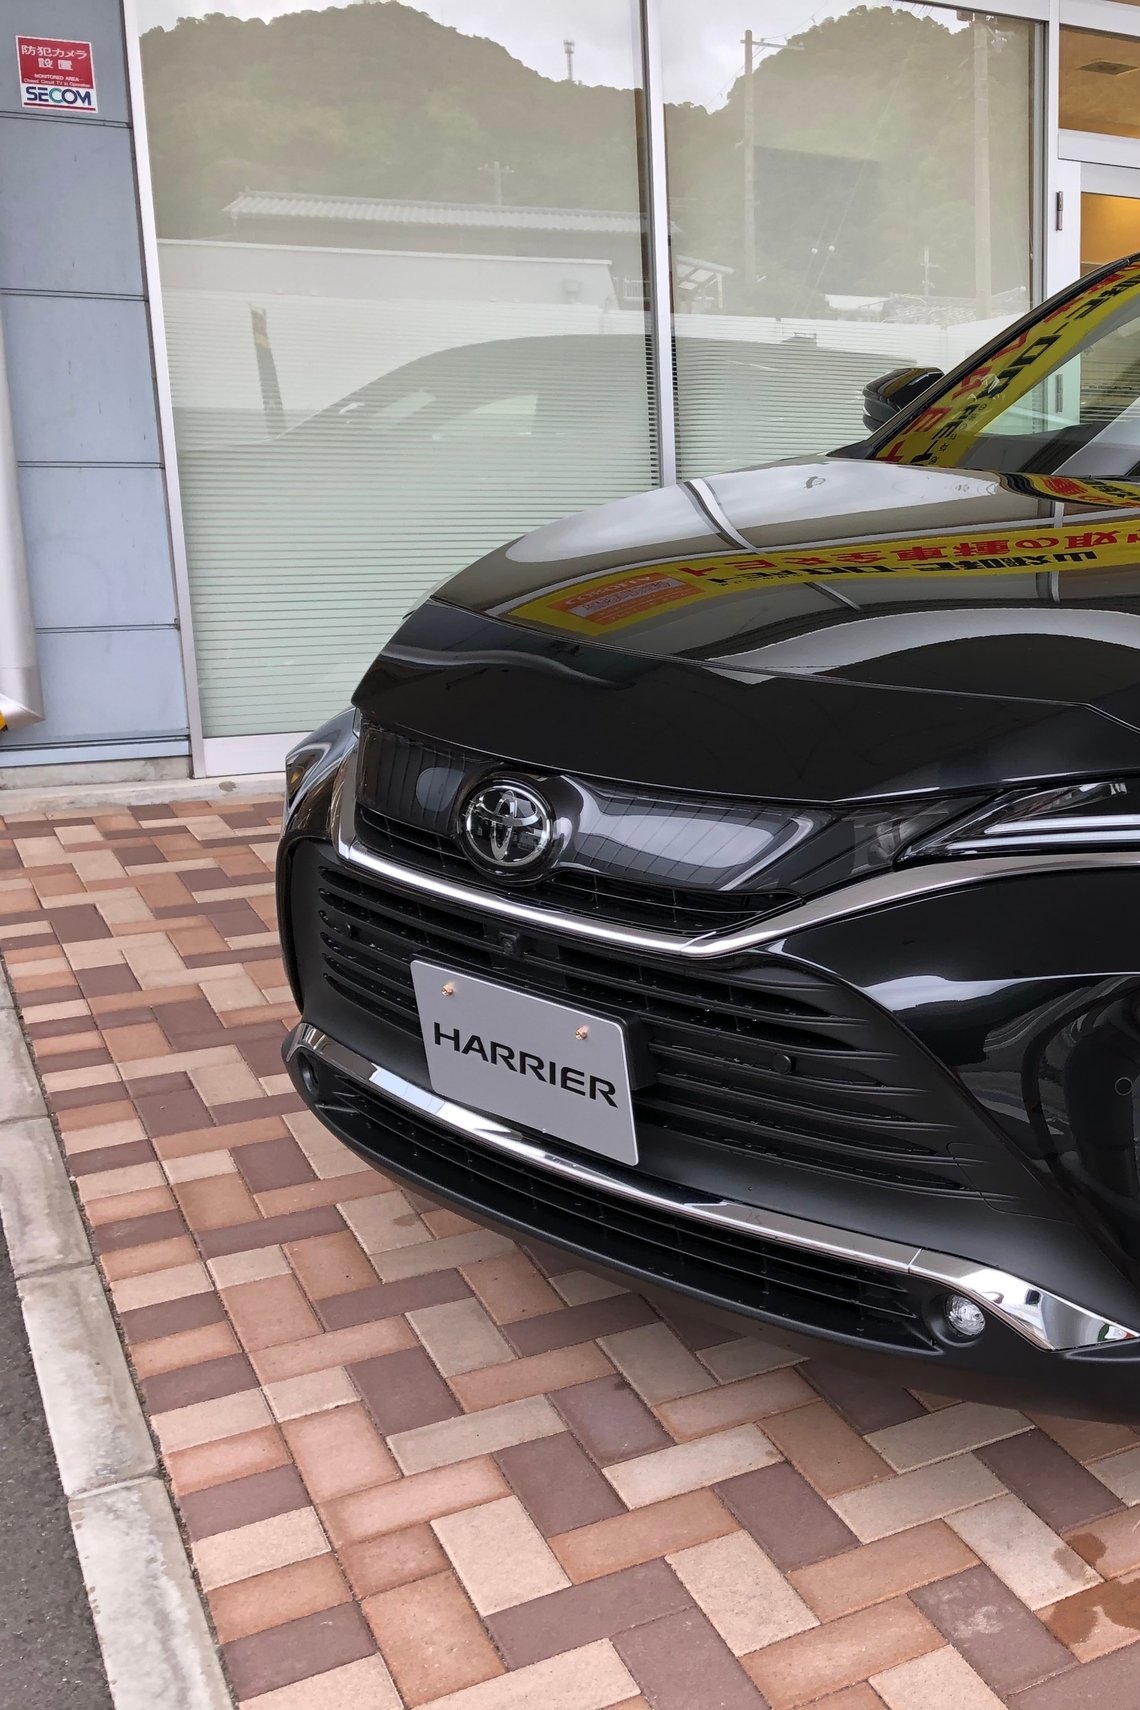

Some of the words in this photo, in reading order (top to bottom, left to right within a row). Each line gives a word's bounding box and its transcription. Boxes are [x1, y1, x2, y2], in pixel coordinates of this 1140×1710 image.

[21, 44, 88, 60] 防犯カメラ
[25, 86, 92, 106] SECOM
[433, 1022, 619, 1109] HARRIER
